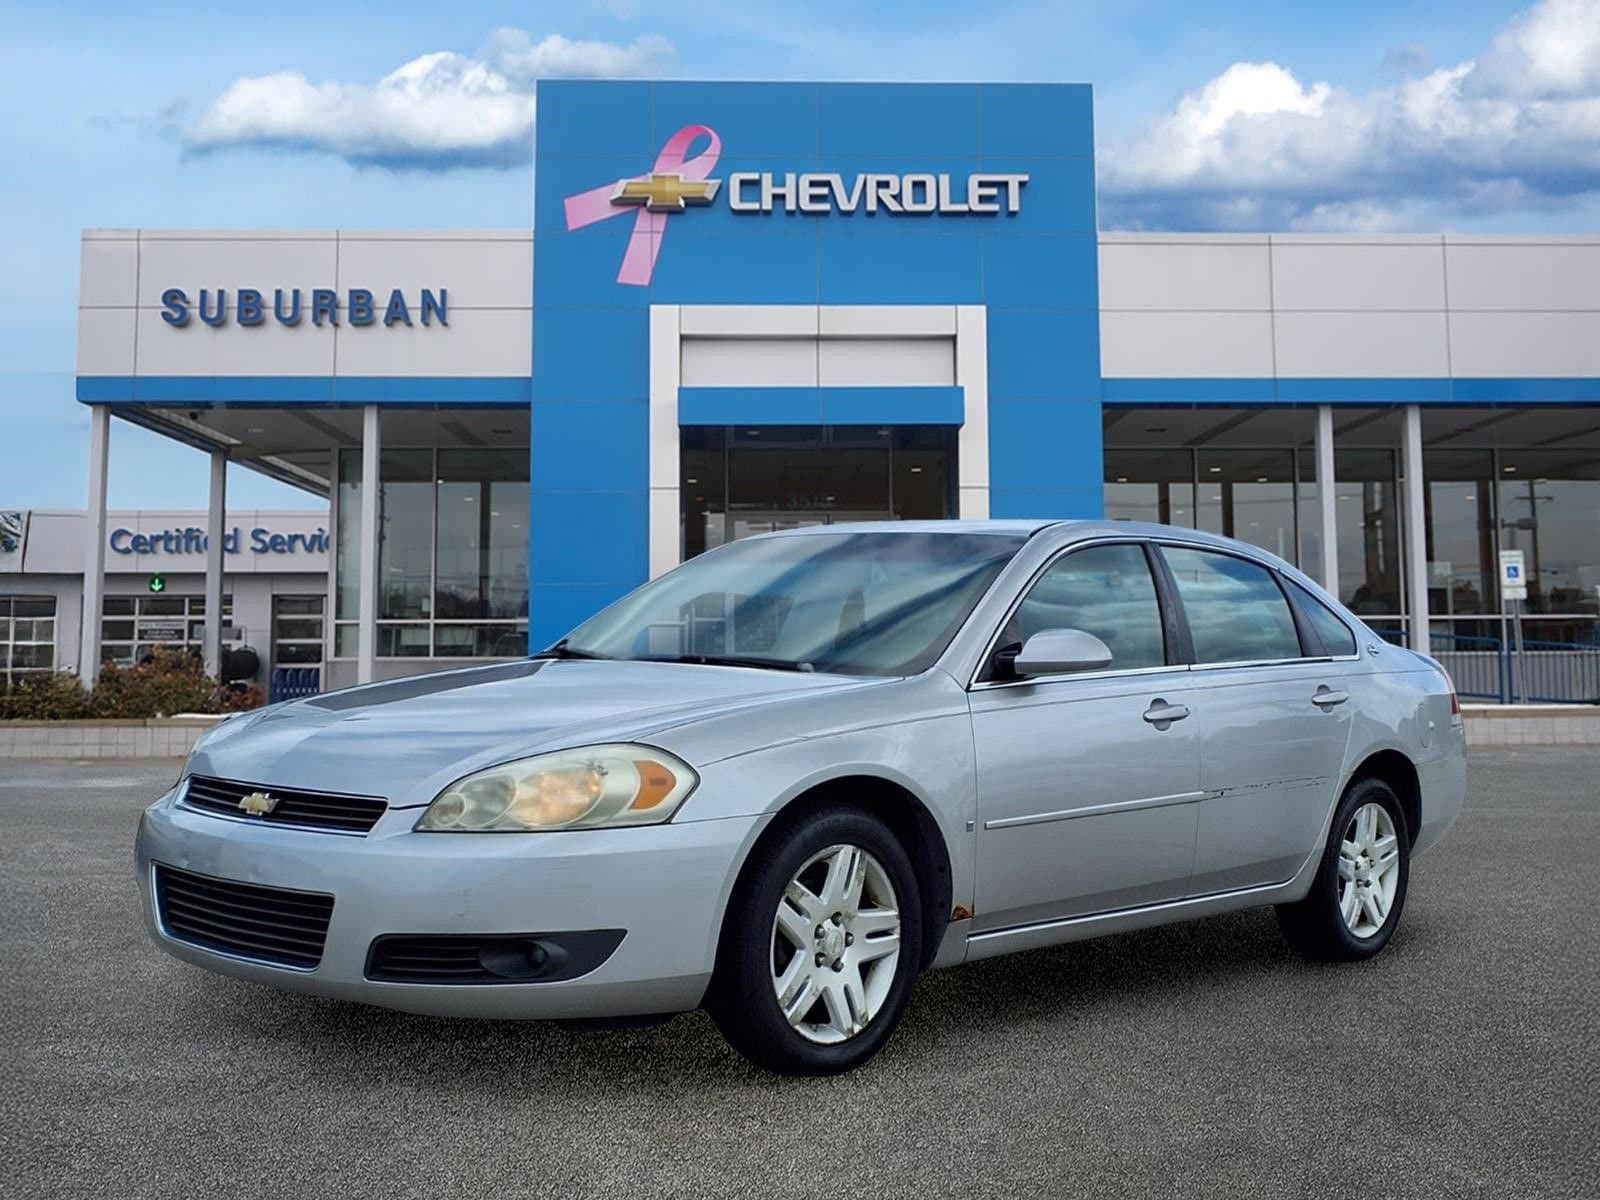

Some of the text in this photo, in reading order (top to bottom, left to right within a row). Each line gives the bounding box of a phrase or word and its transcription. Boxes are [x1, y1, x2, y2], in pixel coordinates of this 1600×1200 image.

[729, 172, 1030, 213] CHEVROLET
[160, 288, 449, 327] SUBURBAN
[249, 527, 330, 554] Servi
